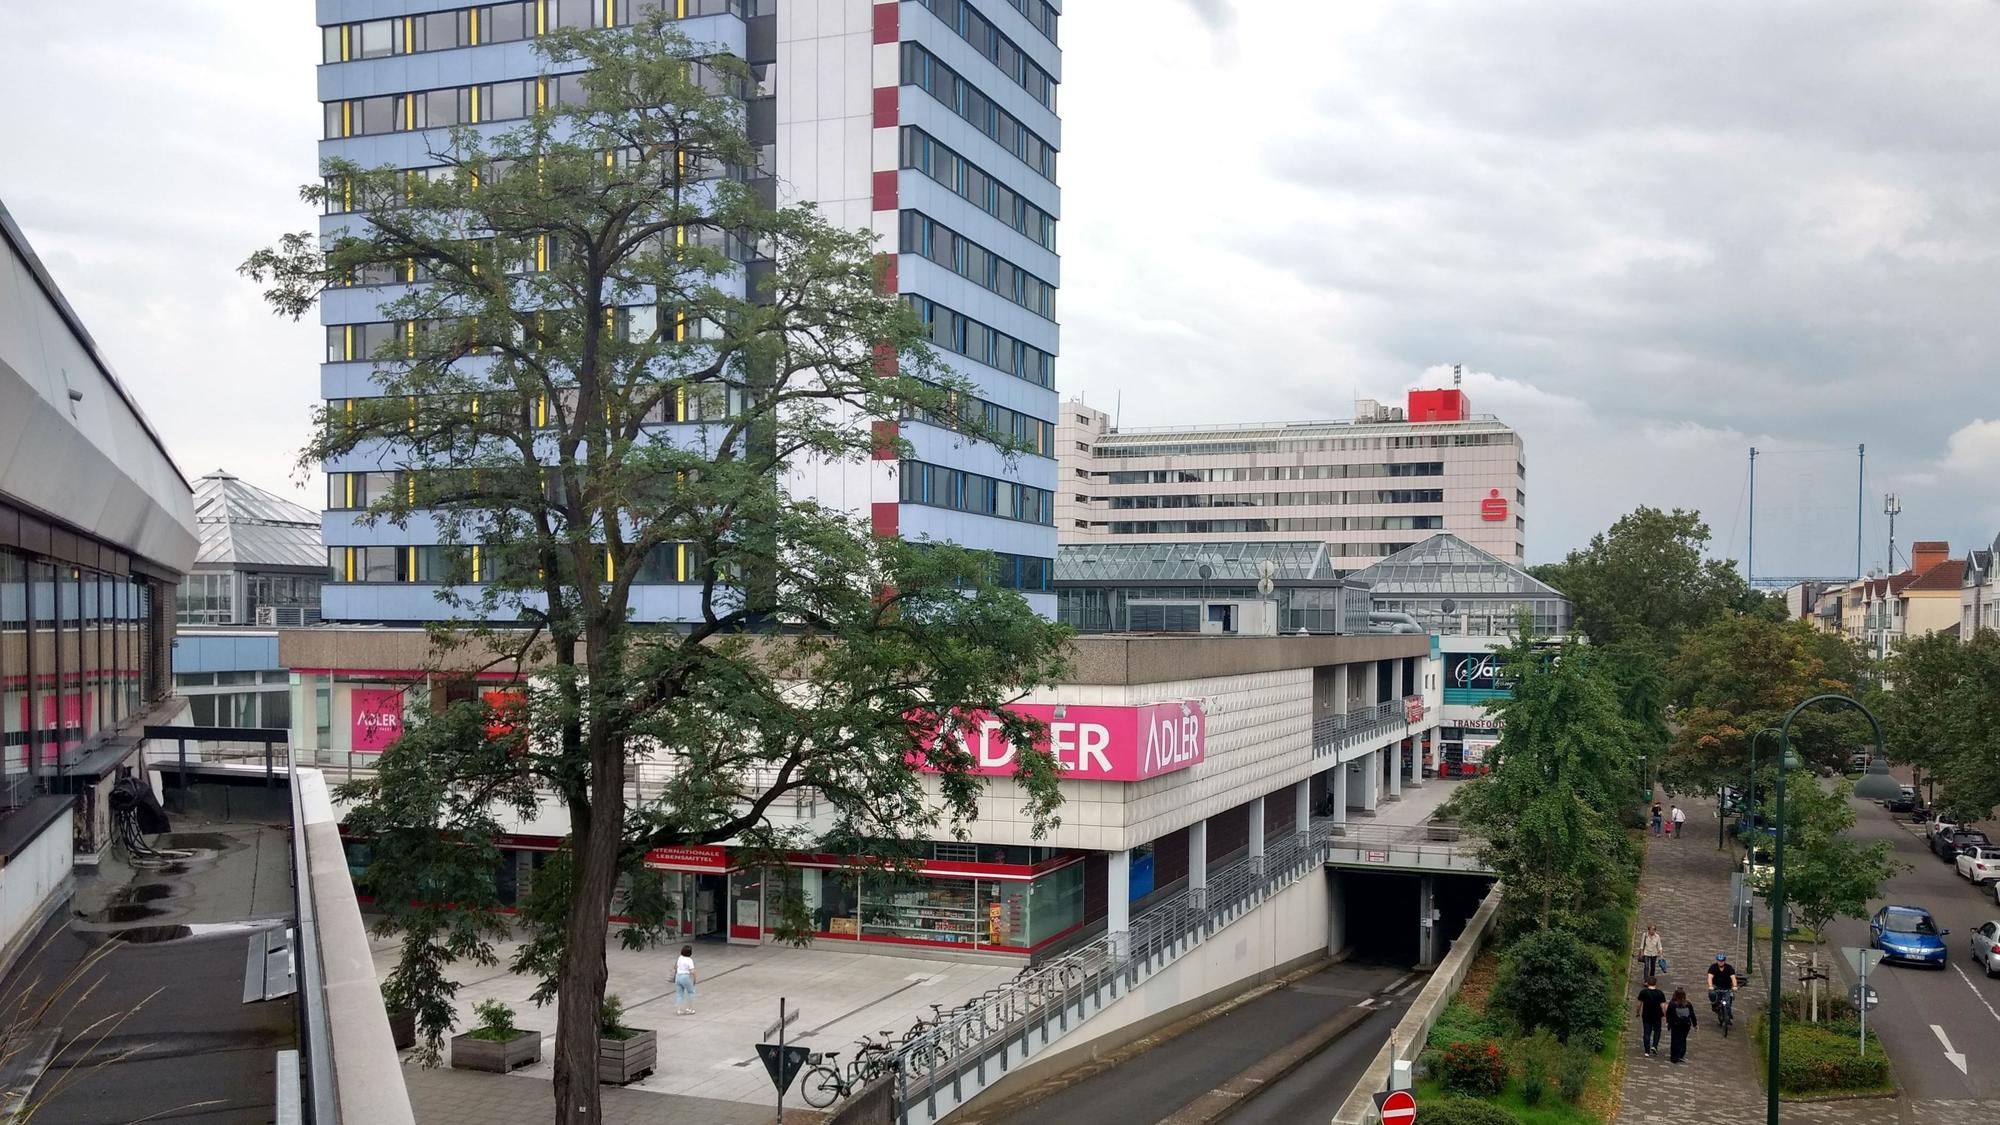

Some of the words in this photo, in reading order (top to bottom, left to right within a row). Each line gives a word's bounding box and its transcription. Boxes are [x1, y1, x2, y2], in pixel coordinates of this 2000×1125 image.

[925, 708, 1113, 773] ADER
[1144, 710, 1199, 774] ADLER
[656, 854, 713, 862] LEBENSMITTEL
